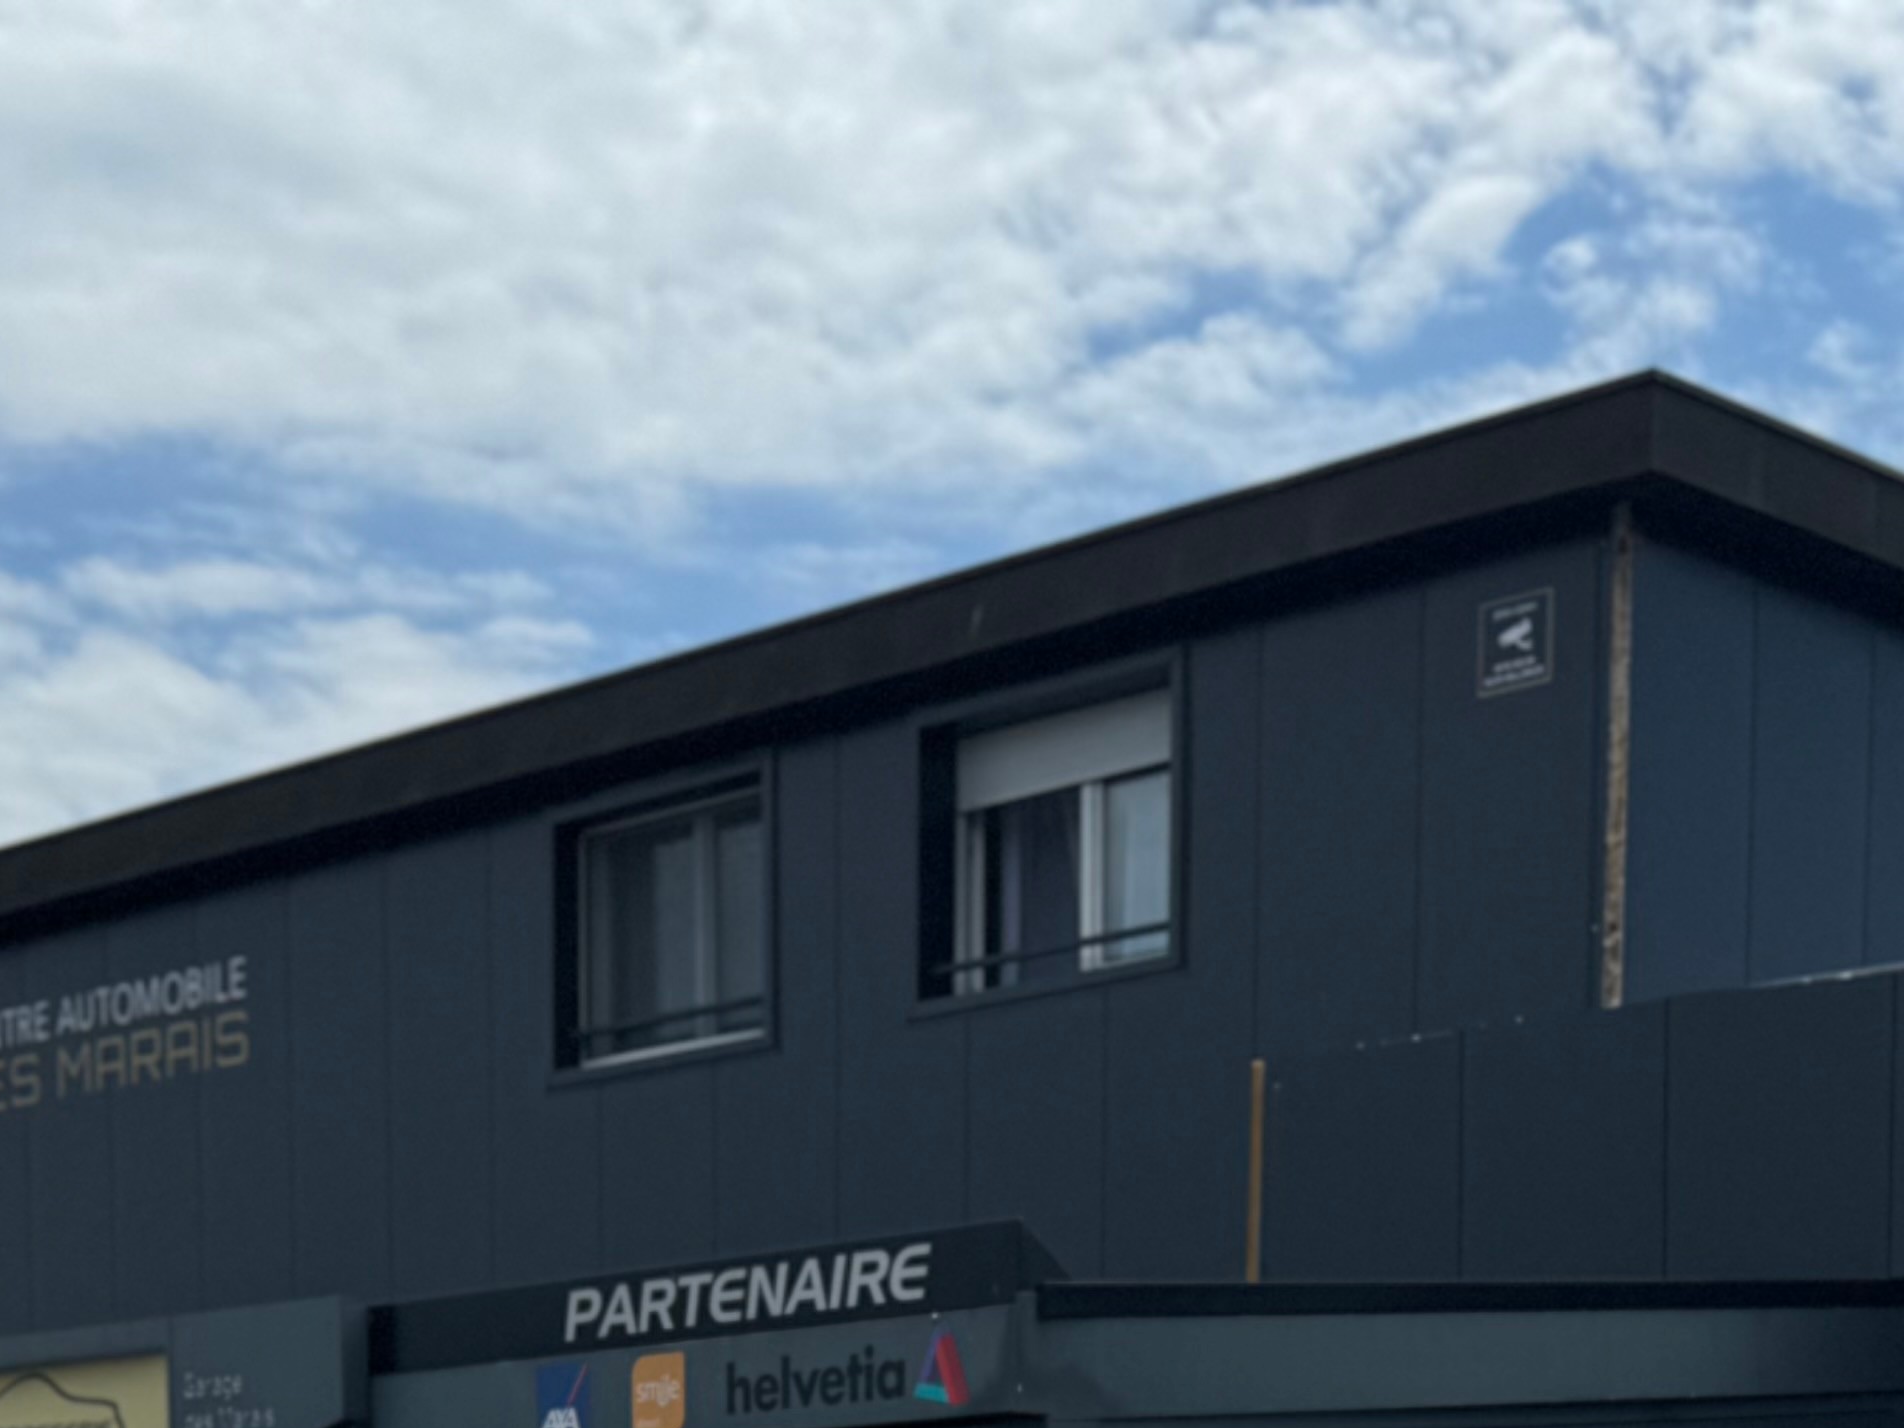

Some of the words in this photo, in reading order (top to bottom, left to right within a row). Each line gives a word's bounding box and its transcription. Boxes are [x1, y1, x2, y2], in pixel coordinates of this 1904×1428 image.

[55, 955, 248, 1036] AUTOMOBILE
[56, 1010, 250, 1098] MARAIS
[564, 1243, 932, 1343] PARTENAIRE
[635, 1374, 681, 1408] smile
[726, 1345, 905, 1416] helvetia
